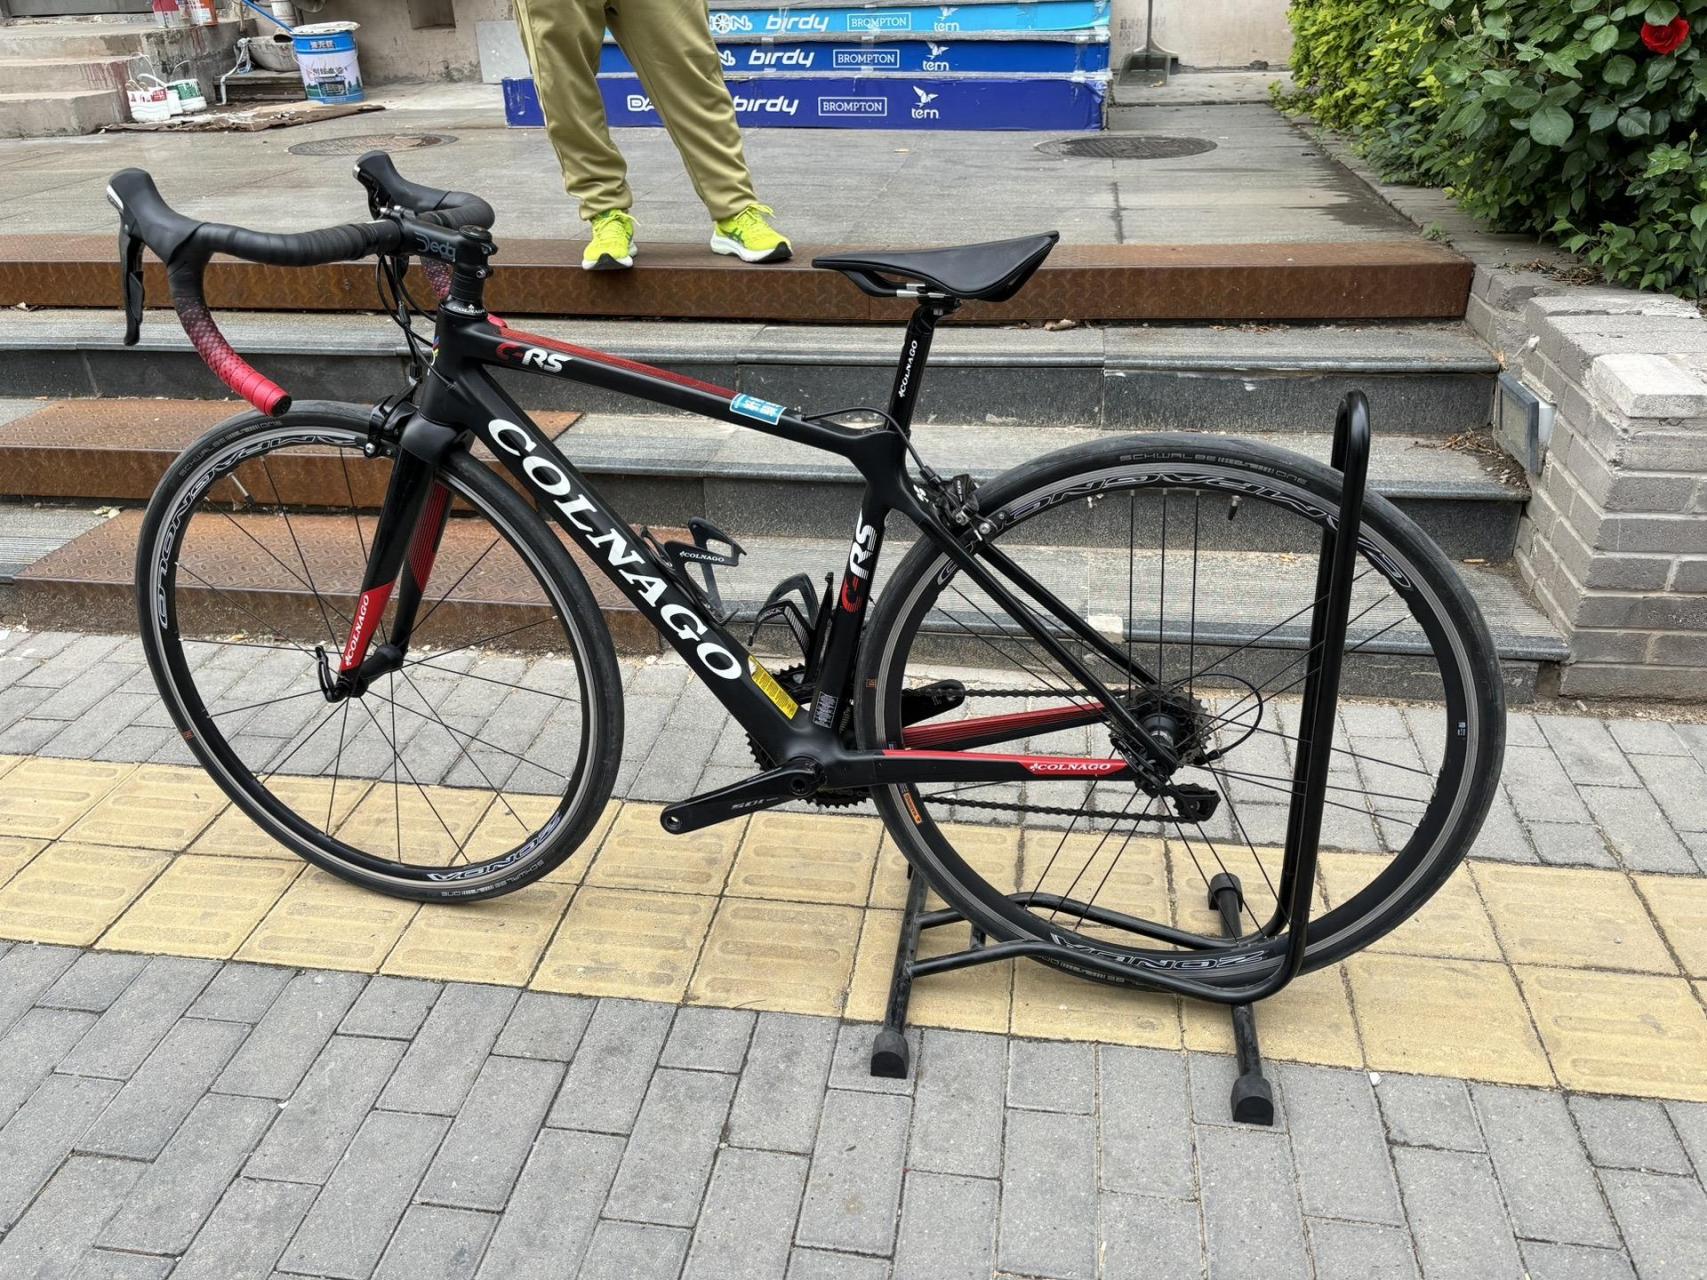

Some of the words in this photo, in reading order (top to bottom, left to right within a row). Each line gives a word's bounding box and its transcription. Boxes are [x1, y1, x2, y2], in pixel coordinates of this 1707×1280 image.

[765, 13, 830, 32] birdy
[851, 16, 906, 28] BROMPTON
[933, 21, 960, 32] tern
[748, 48, 815, 67] birdy
[837, 52, 895, 63] BROMPTON
[922, 60, 949, 71] tern
[733, 95, 799, 115] birdy
[823, 101, 883, 112] BROMPTON
[911, 107, 939, 119] tern
[900, 340, 918, 394] COLNAGO
[488, 418, 743, 680] COLNAGO
[683, 551, 725, 563] COLNAGO
[348, 594, 370, 662] COLNAGO
[1037, 761, 1111, 772] COLNAGO
